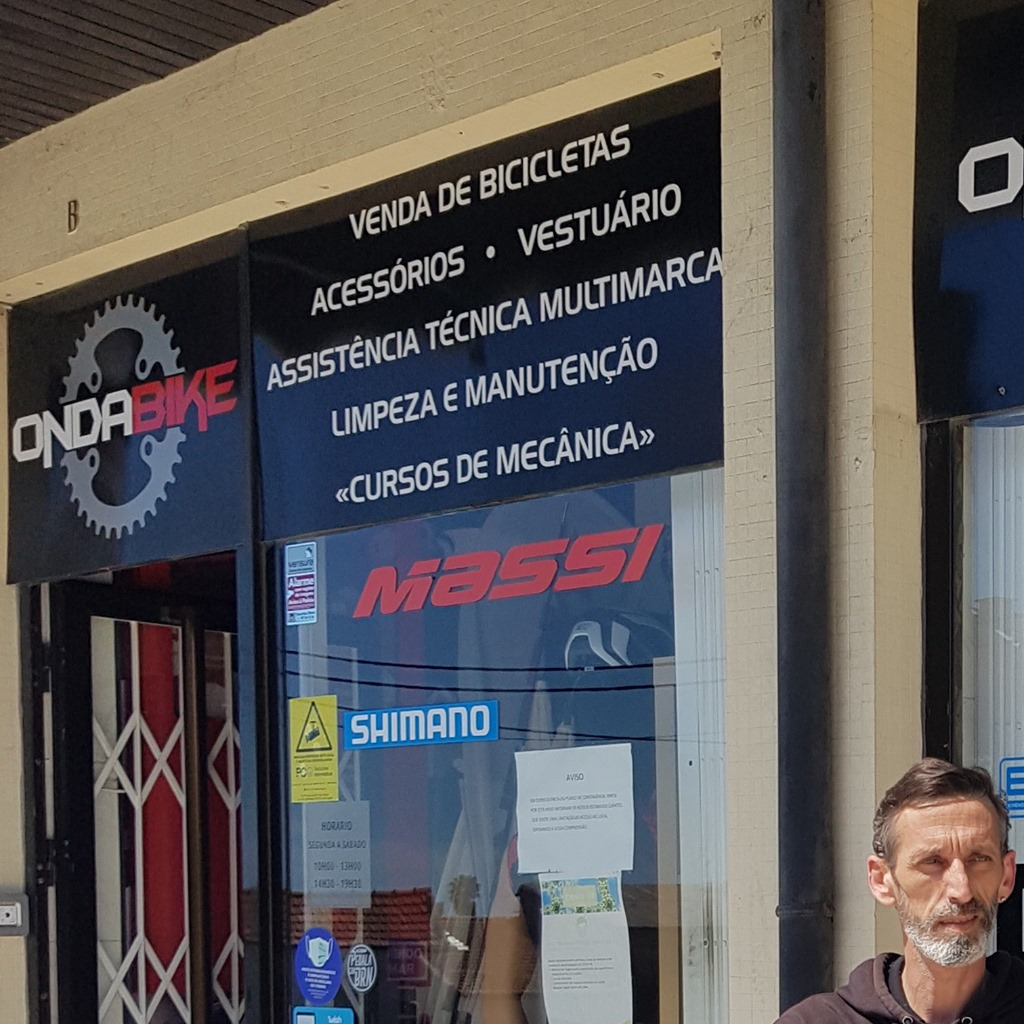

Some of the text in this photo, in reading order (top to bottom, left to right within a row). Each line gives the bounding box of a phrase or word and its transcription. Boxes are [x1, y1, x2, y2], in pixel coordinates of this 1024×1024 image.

[348, 124, 632, 241] VENDA DE BICICLETAS
[311, 182, 683, 316] ACESSÓRIOS VESTUÁRIO
[266, 247, 722, 391] ASSISTÊNCIA TÉCNICA MULTIMARCA
[12, 359, 239, 468] ONDABIKE
[331, 336, 660, 437] LIMPEZA E MANUTENÇÃO
[457, 450, 489, 484] DE
[350, 705, 490, 746] SHIMANO
[566, 772, 584, 782] AVISO
